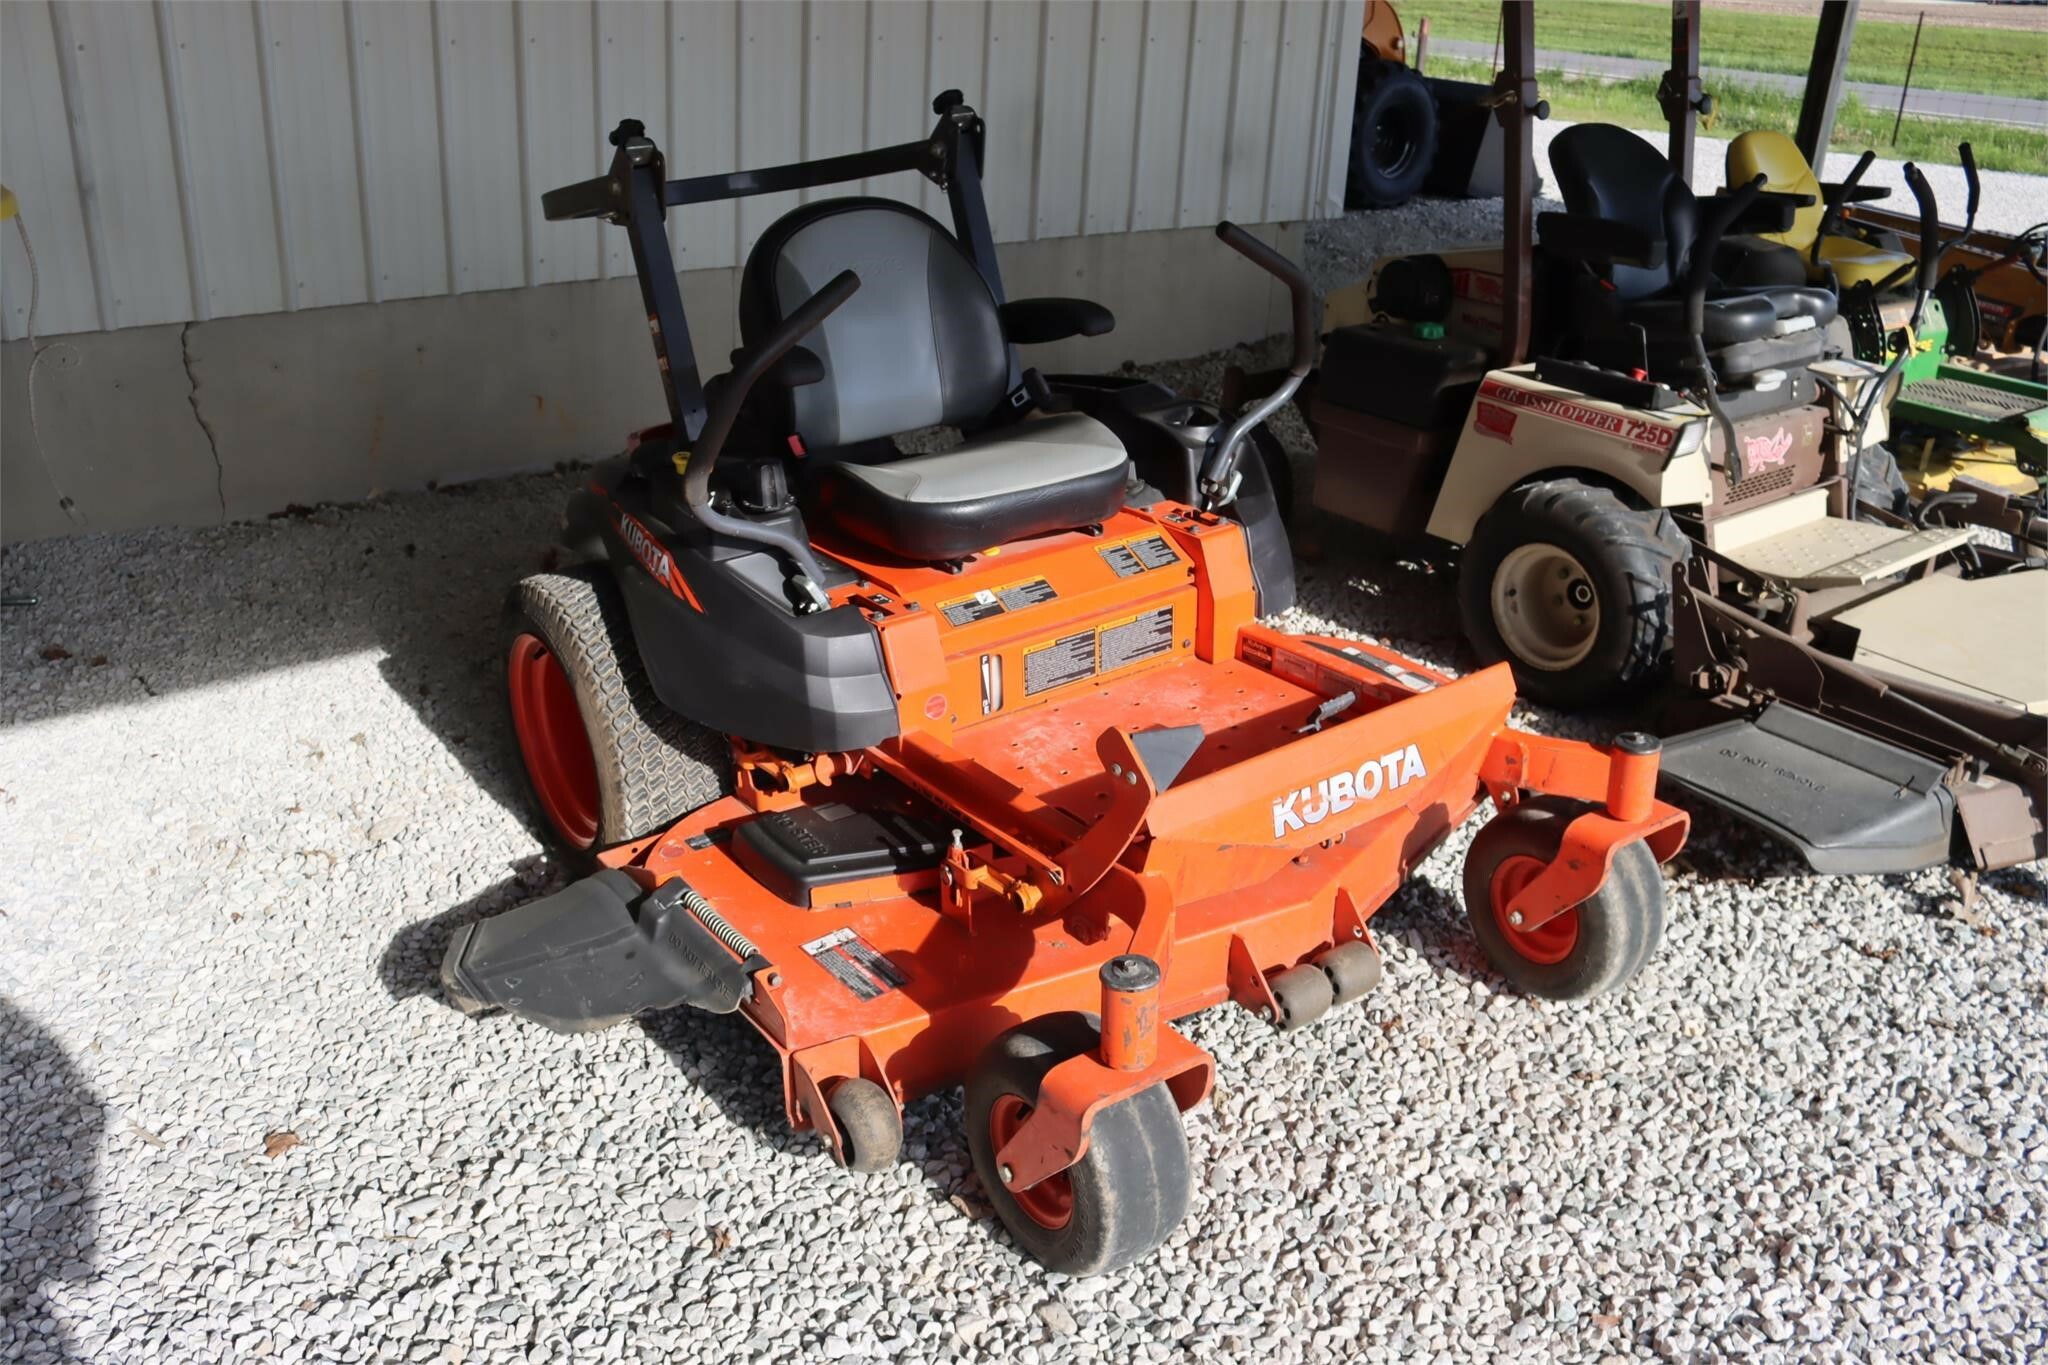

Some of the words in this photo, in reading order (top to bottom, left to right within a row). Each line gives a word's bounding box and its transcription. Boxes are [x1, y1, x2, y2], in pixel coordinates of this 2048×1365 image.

[1496, 387, 1617, 430] GRASSHOPPER
[1626, 420, 1673, 446] 725D
[620, 513, 670, 581] KUBOTA
[1273, 744, 1426, 838] KUBOTA
[1719, 748, 1739, 759] DO
[1742, 755, 1769, 769] NOT
[668, 931, 683, 949] DO
[681, 945, 699, 966] NOT
[697, 962, 735, 1001] REMOVE
